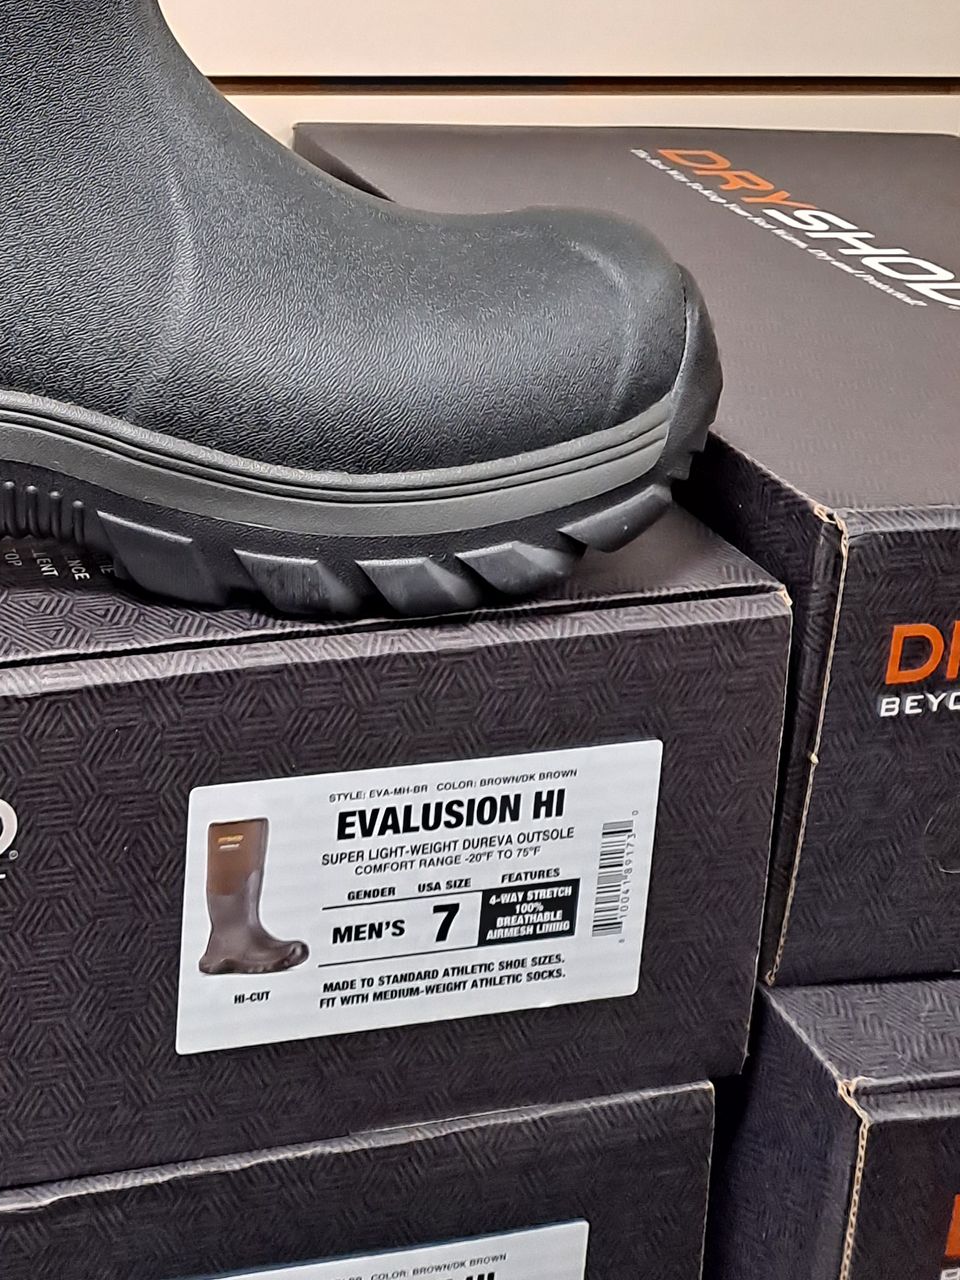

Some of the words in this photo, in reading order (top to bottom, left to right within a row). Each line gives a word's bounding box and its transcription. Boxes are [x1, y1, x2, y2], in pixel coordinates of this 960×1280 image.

[31, 549, 59, 577] LENT
[65, 559, 90, 581] NCE
[539, 769, 577, 781] BROWN
[337, 793, 522, 841] EVALUSION
[532, 788, 566, 820] HI
[321, 850, 364, 865] SUPER
[368, 840, 459, 861] LIGHT-WEIGHT
[462, 834, 513, 850] DUREVA
[517, 827, 575, 845] OUTSOLE
[355, 860, 416, 875] COMFORT
[419, 855, 462, 868] RANGE
[497, 849, 512, 860] TO
[501, 867, 560, 884] FEATURES
[347, 886, 396, 901] GENDER
[417, 881, 442, 893] USA
[445, 878, 472, 890] SIZE
[489, 891, 525, 905] 4-WAY
[527, 886, 572, 901] STRETCH
[515, 902, 544, 914] 100%
[432, 902, 460, 943] 7
[496, 910, 563, 928] BREATHABLE
[332, 920, 406, 944] MEN'S
[486, 925, 533, 940] AIRMESH
[323, 980, 357, 993] MADE
[361, 978, 375, 989] TO
[378, 969, 439, 986] STANDARD
[442, 962, 494, 978] ATHLETIC
[498, 958, 528, 971] SHOE
[531, 953, 565, 966] SIZES.
[234, 991, 271, 1005] HI-CUT
[320, 997, 337, 1009] FIT
[340, 993, 369, 1006] WITH
[372, 980, 468, 1002] MEDIUM-WEIGHT
[471, 973, 522, 989] ATHLETIC
[526, 968, 565, 982] SOCKS.
[469, 1253, 506, 1267] BROWN
